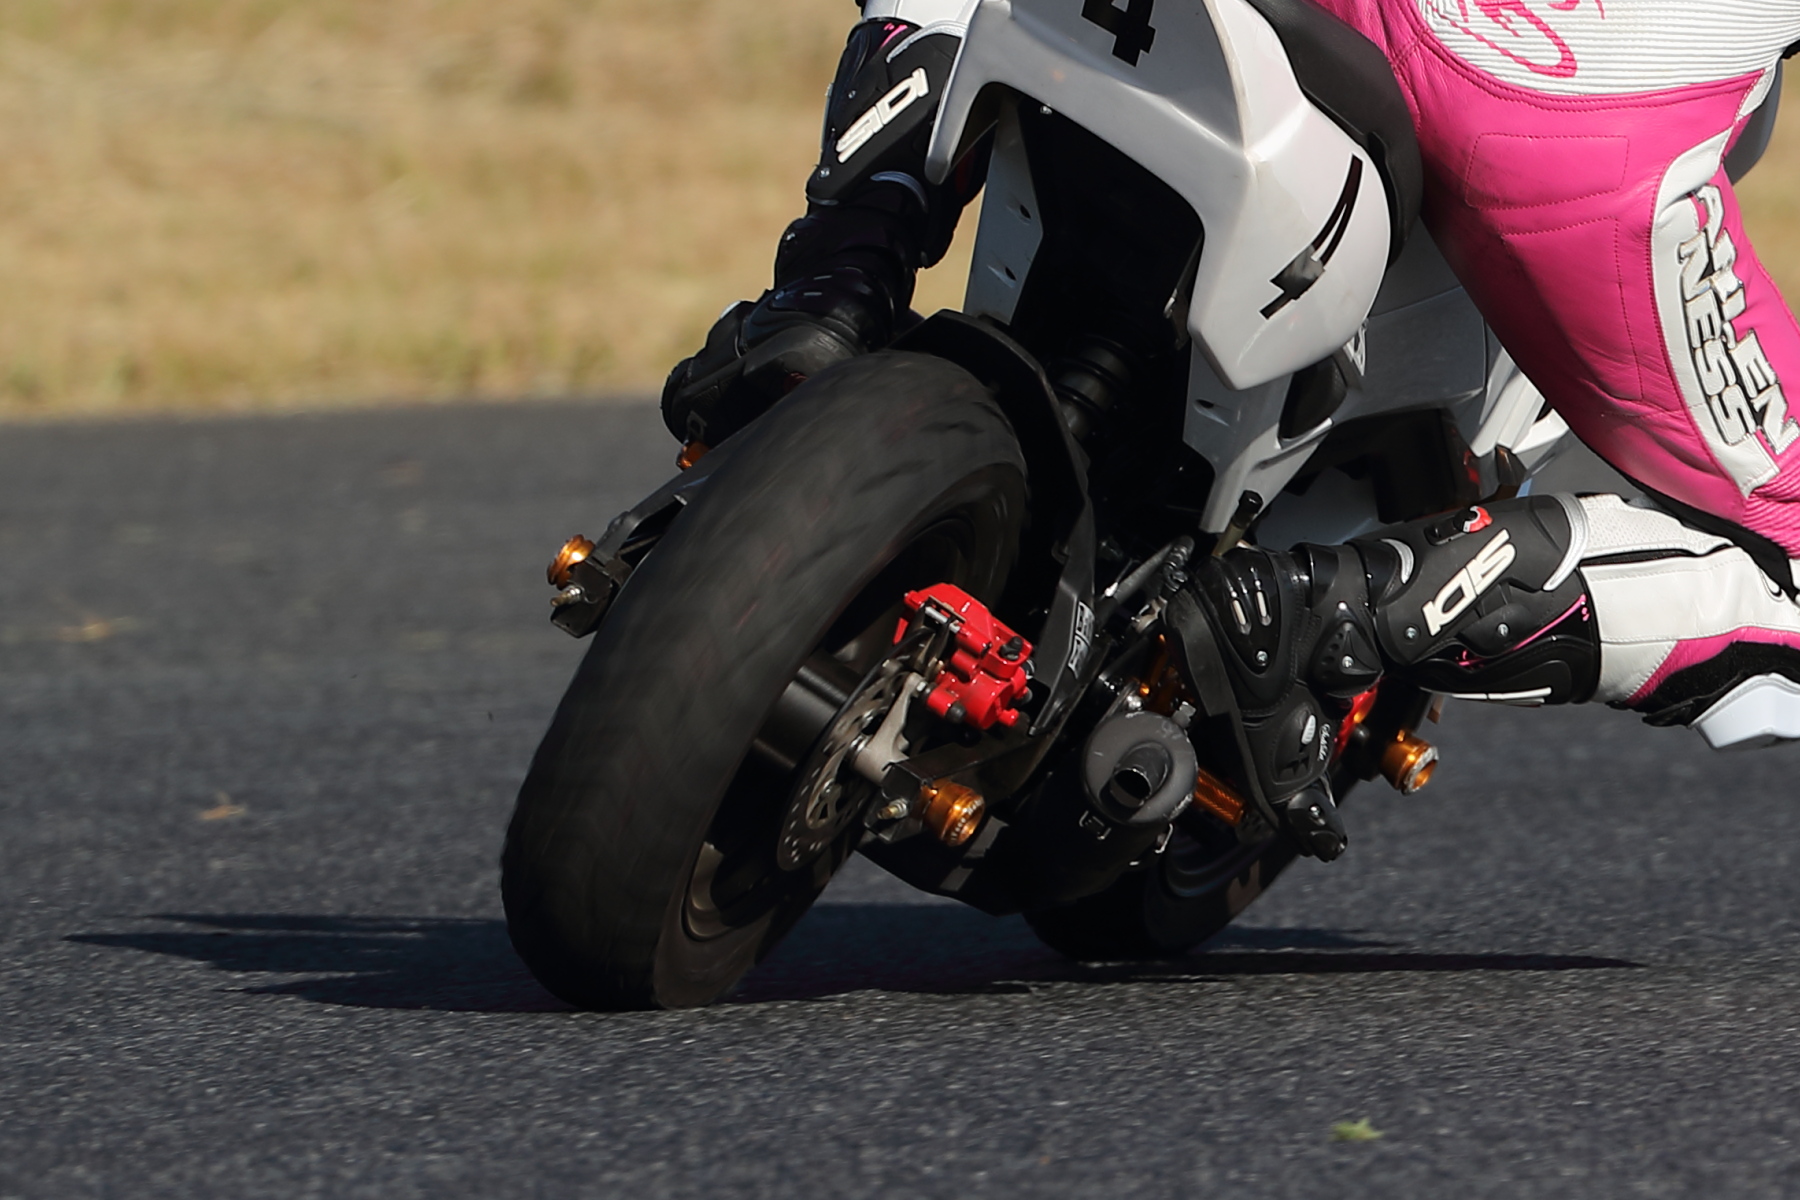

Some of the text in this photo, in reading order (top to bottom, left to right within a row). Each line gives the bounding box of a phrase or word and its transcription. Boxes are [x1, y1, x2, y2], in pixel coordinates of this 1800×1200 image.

[835, 67, 930, 164] SIDI
[1677, 231, 1759, 446] NESS
[1421, 528, 1517, 637] SIDI
